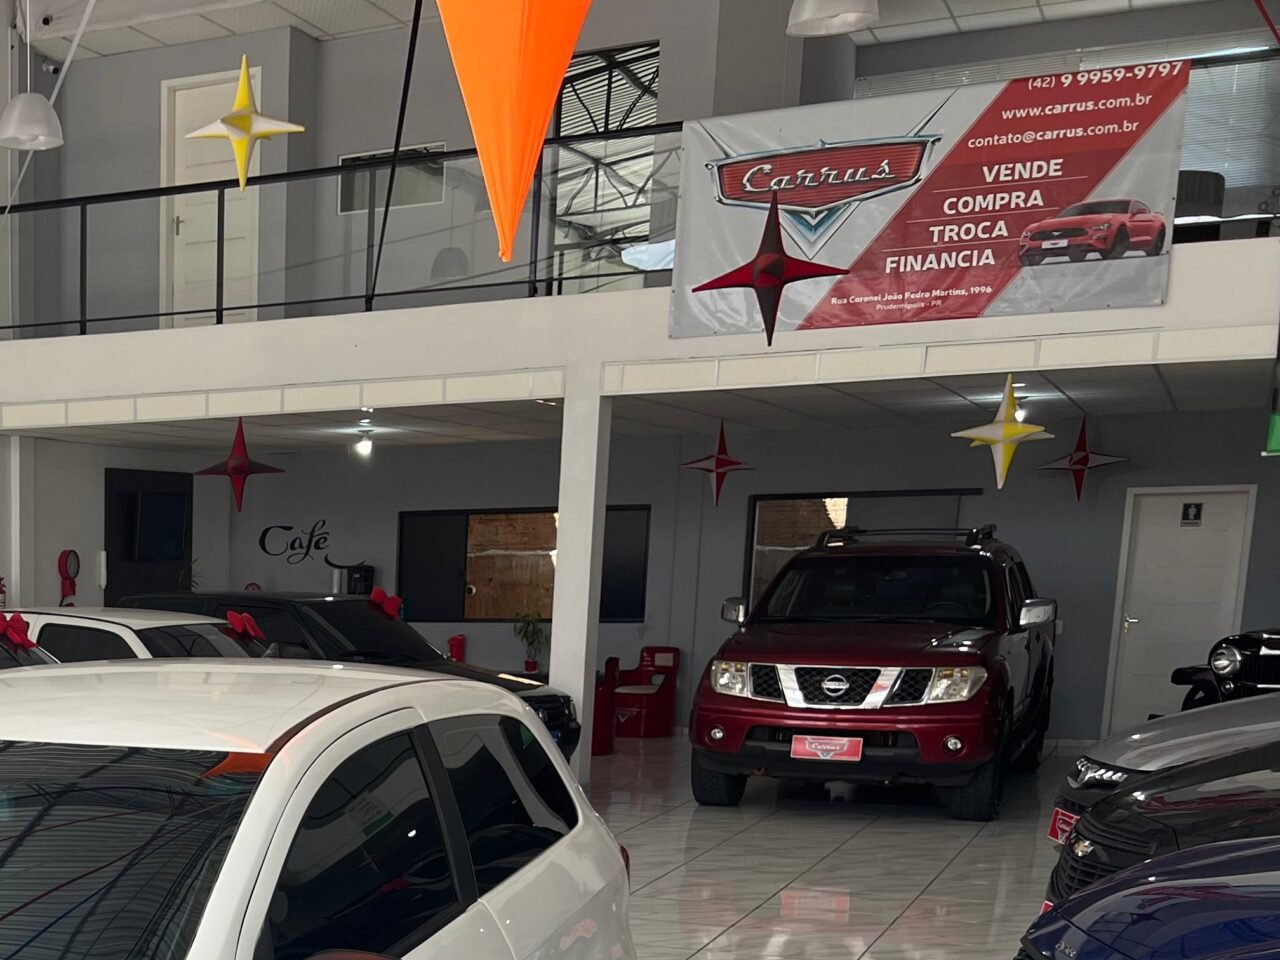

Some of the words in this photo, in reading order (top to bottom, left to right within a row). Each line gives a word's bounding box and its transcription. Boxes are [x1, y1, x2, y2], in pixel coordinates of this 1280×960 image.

[1028, 77, 1056, 90] (42)
[1061, 74, 1073, 87] 9
[1077, 61, 1184, 86] 9959-9797
[1001, 93, 1152, 120] www.carrus.com.br
[967, 120, 1139, 148] contato@carrus.com.br
[742, 159, 896, 192] Carrus
[982, 158, 1064, 183] VENDE
[943, 189, 1044, 215] COMPRA
[928, 220, 1009, 243] TROCA
[885, 248, 996, 273] FINANCIA
[831, 297, 847, 305] Rua
[904, 290, 930, 299] Pedro
[931, 288, 968, 297] Martins,
[970, 286, 992, 294] 1996
[258, 519, 330, 565] Café
